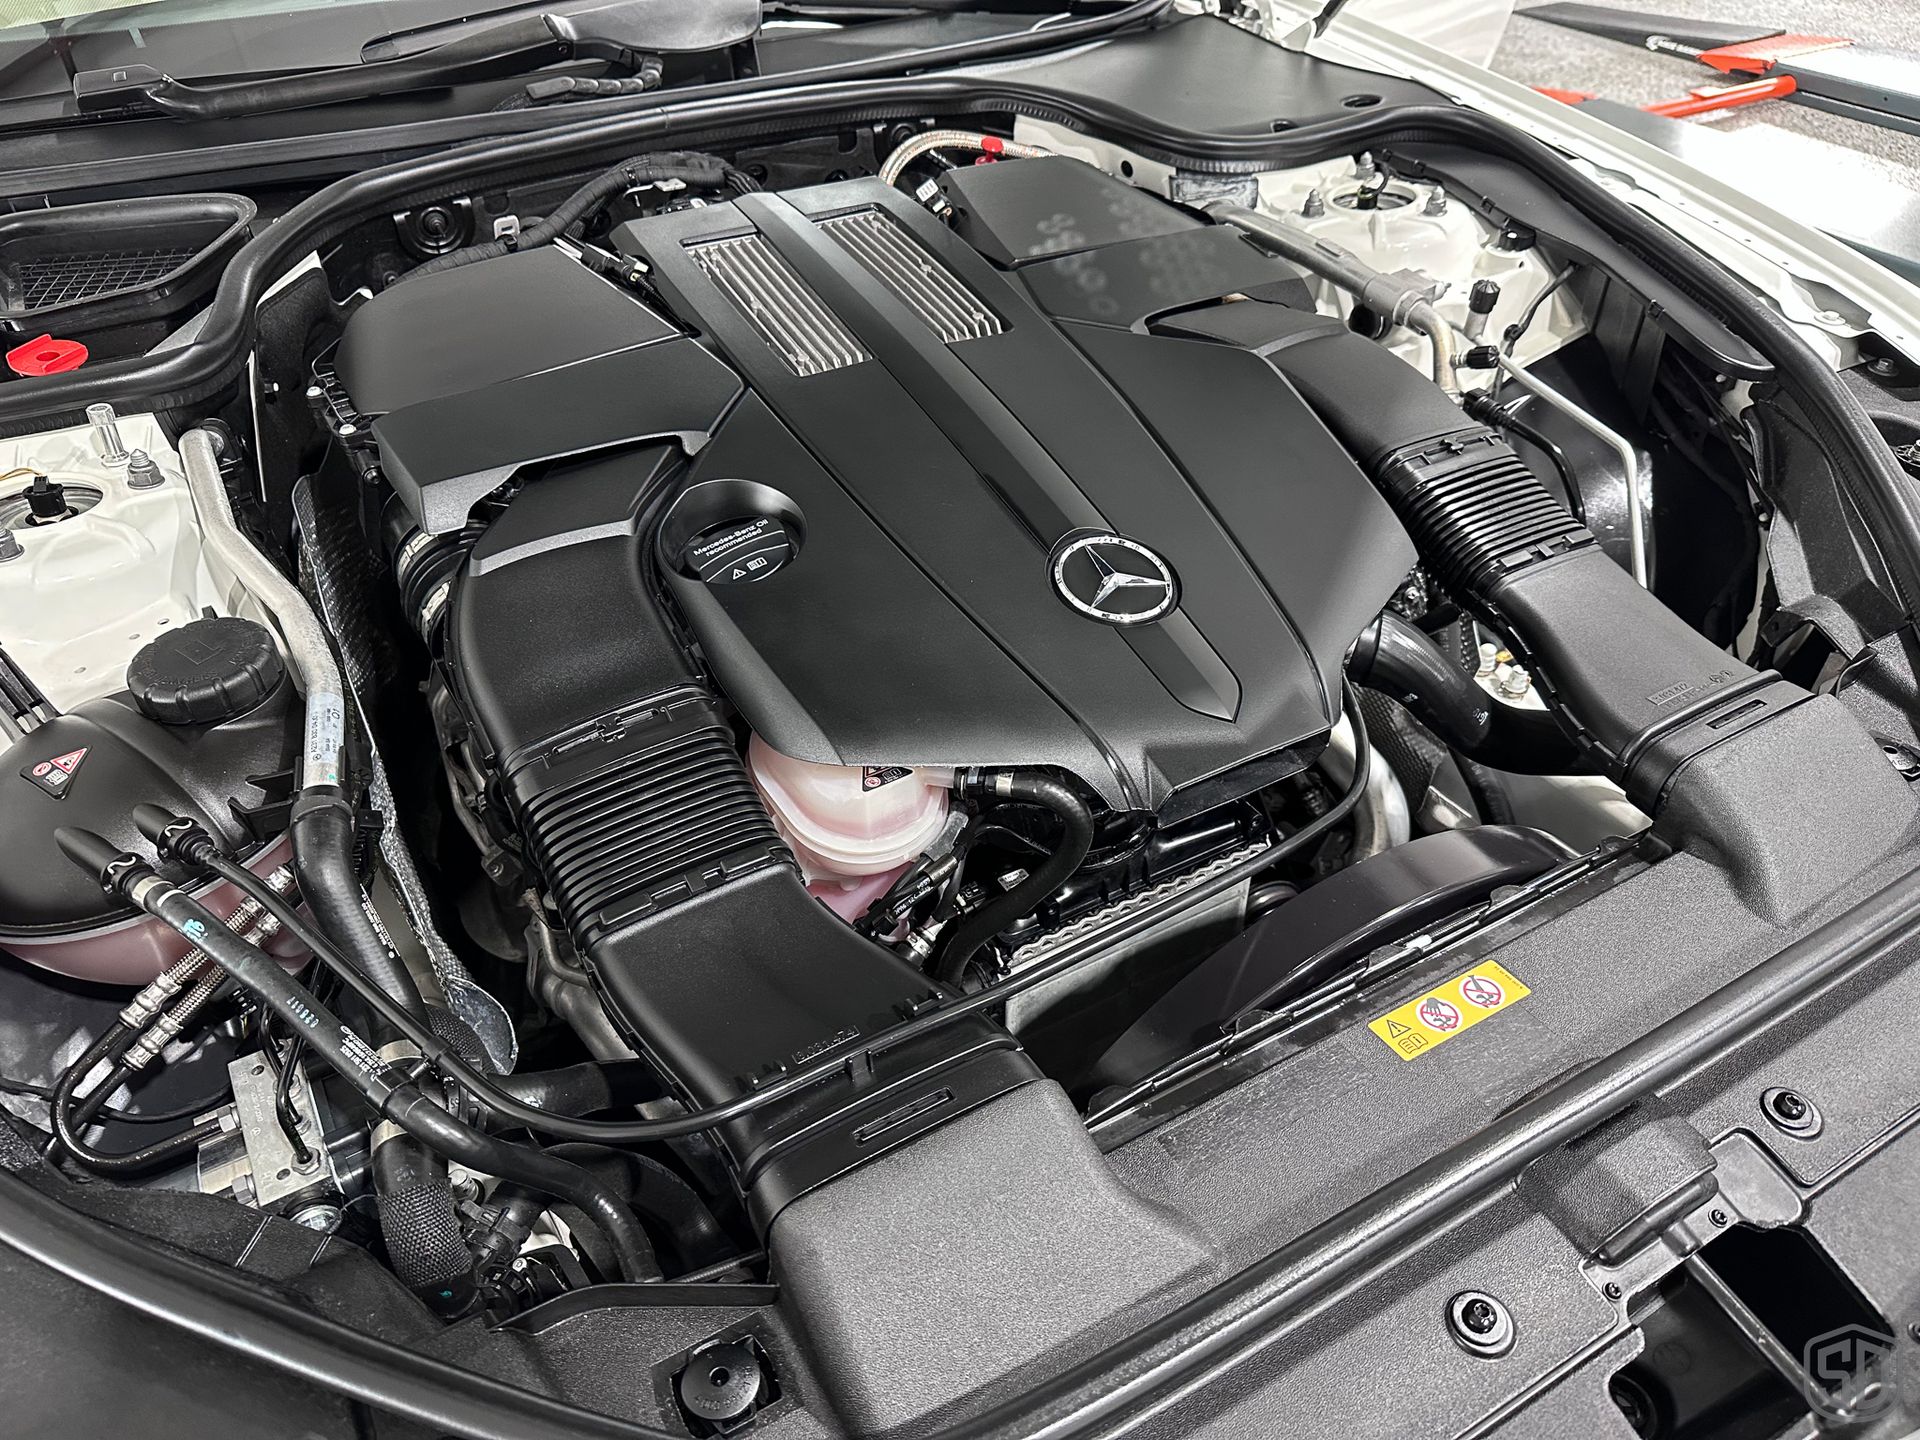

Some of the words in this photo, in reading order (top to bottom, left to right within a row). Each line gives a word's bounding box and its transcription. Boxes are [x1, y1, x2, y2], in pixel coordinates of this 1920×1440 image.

[693, 524, 756, 556] Mercedes-Benz
[756, 519, 769, 529] Oil
[705, 528, 763, 557] recommended
